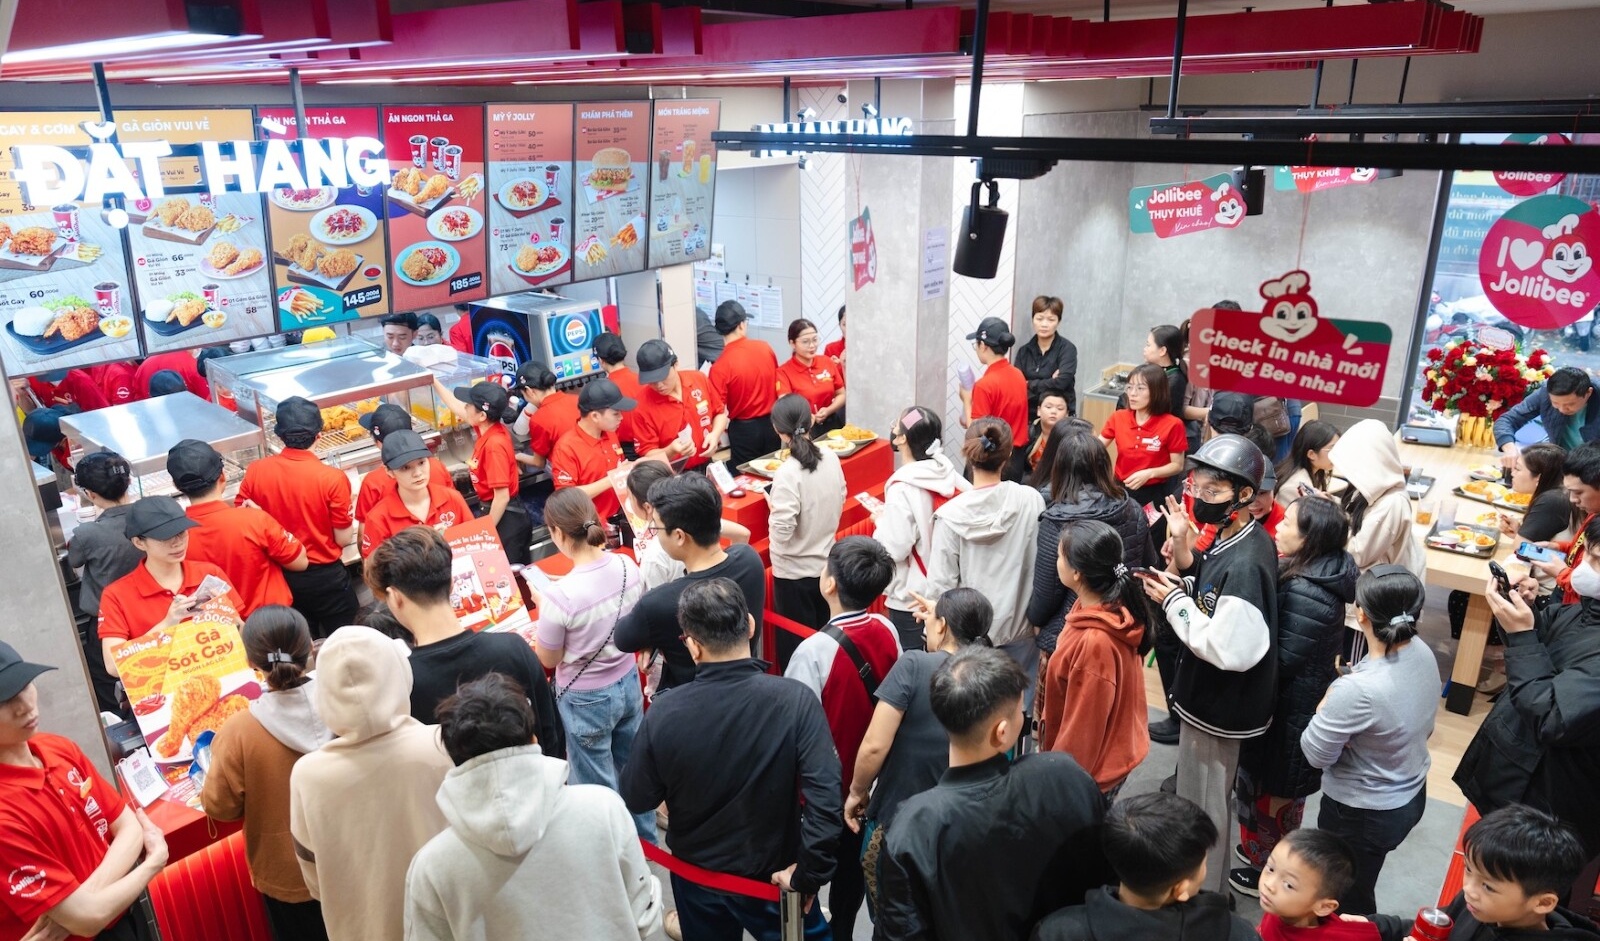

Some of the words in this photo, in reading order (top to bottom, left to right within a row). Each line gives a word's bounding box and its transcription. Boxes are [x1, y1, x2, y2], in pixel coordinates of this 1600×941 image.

[282, 116, 310, 125] NGN
[312, 112, 331, 124] THẢ
[332, 116, 346, 124] GA
[388, 113, 400, 122] ĂN
[402, 114, 424, 122] NGON
[426, 110, 442, 122] THẢ
[442, 114, 454, 122] GA
[493, 111, 506, 122] MỲ
[506, 110, 512, 121] Ý
[512, 112, 536, 121] JOLLY
[581, 110, 602, 119] KHÁM
[602, 110, 614, 118] PHÁ
[658, 108, 672, 116] MÓN
[30, 124, 40, 134] &
[42, 123, 76, 134] CƠM
[122, 119, 140, 132] GÀ
[142, 118, 172, 132] GIÒN
[173, 121, 193, 130] VUI
[194, 116, 210, 130] VẺ
[11, 121, 173, 229] ĐẶT
[200, 118, 392, 194] HÀNG
[1292, 170, 1316, 180] THỤY
[1316, 167, 1340, 178] KHUÊ
[1149, 187, 1203, 204] Jollibee
[1149, 208, 1175, 221] THỤY
[1176, 204, 1203, 218] KHUÊ
[1496, 236, 1510, 268] I
[1490, 270, 1588, 308] Jollibee
[246, 306, 257, 314] 58
[567, 328, 585, 337] PEPSI
[1198, 328, 1268, 358] Check
[1269, 341, 1290, 362] in
[1292, 348, 1334, 372] nhà
[1336, 359, 1382, 381] mới
[1208, 353, 1258, 378] cùng
[1259, 362, 1297, 384] Bee
[1300, 374, 1347, 396] nha!
[196, 629, 221, 645] Gà
[116, 639, 158, 659] Jollibee
[168, 652, 199, 671] Sốt
[201, 641, 234, 660] Cay
[182, 666, 201, 674] NGON
[10, 870, 47, 895] Jollibee
